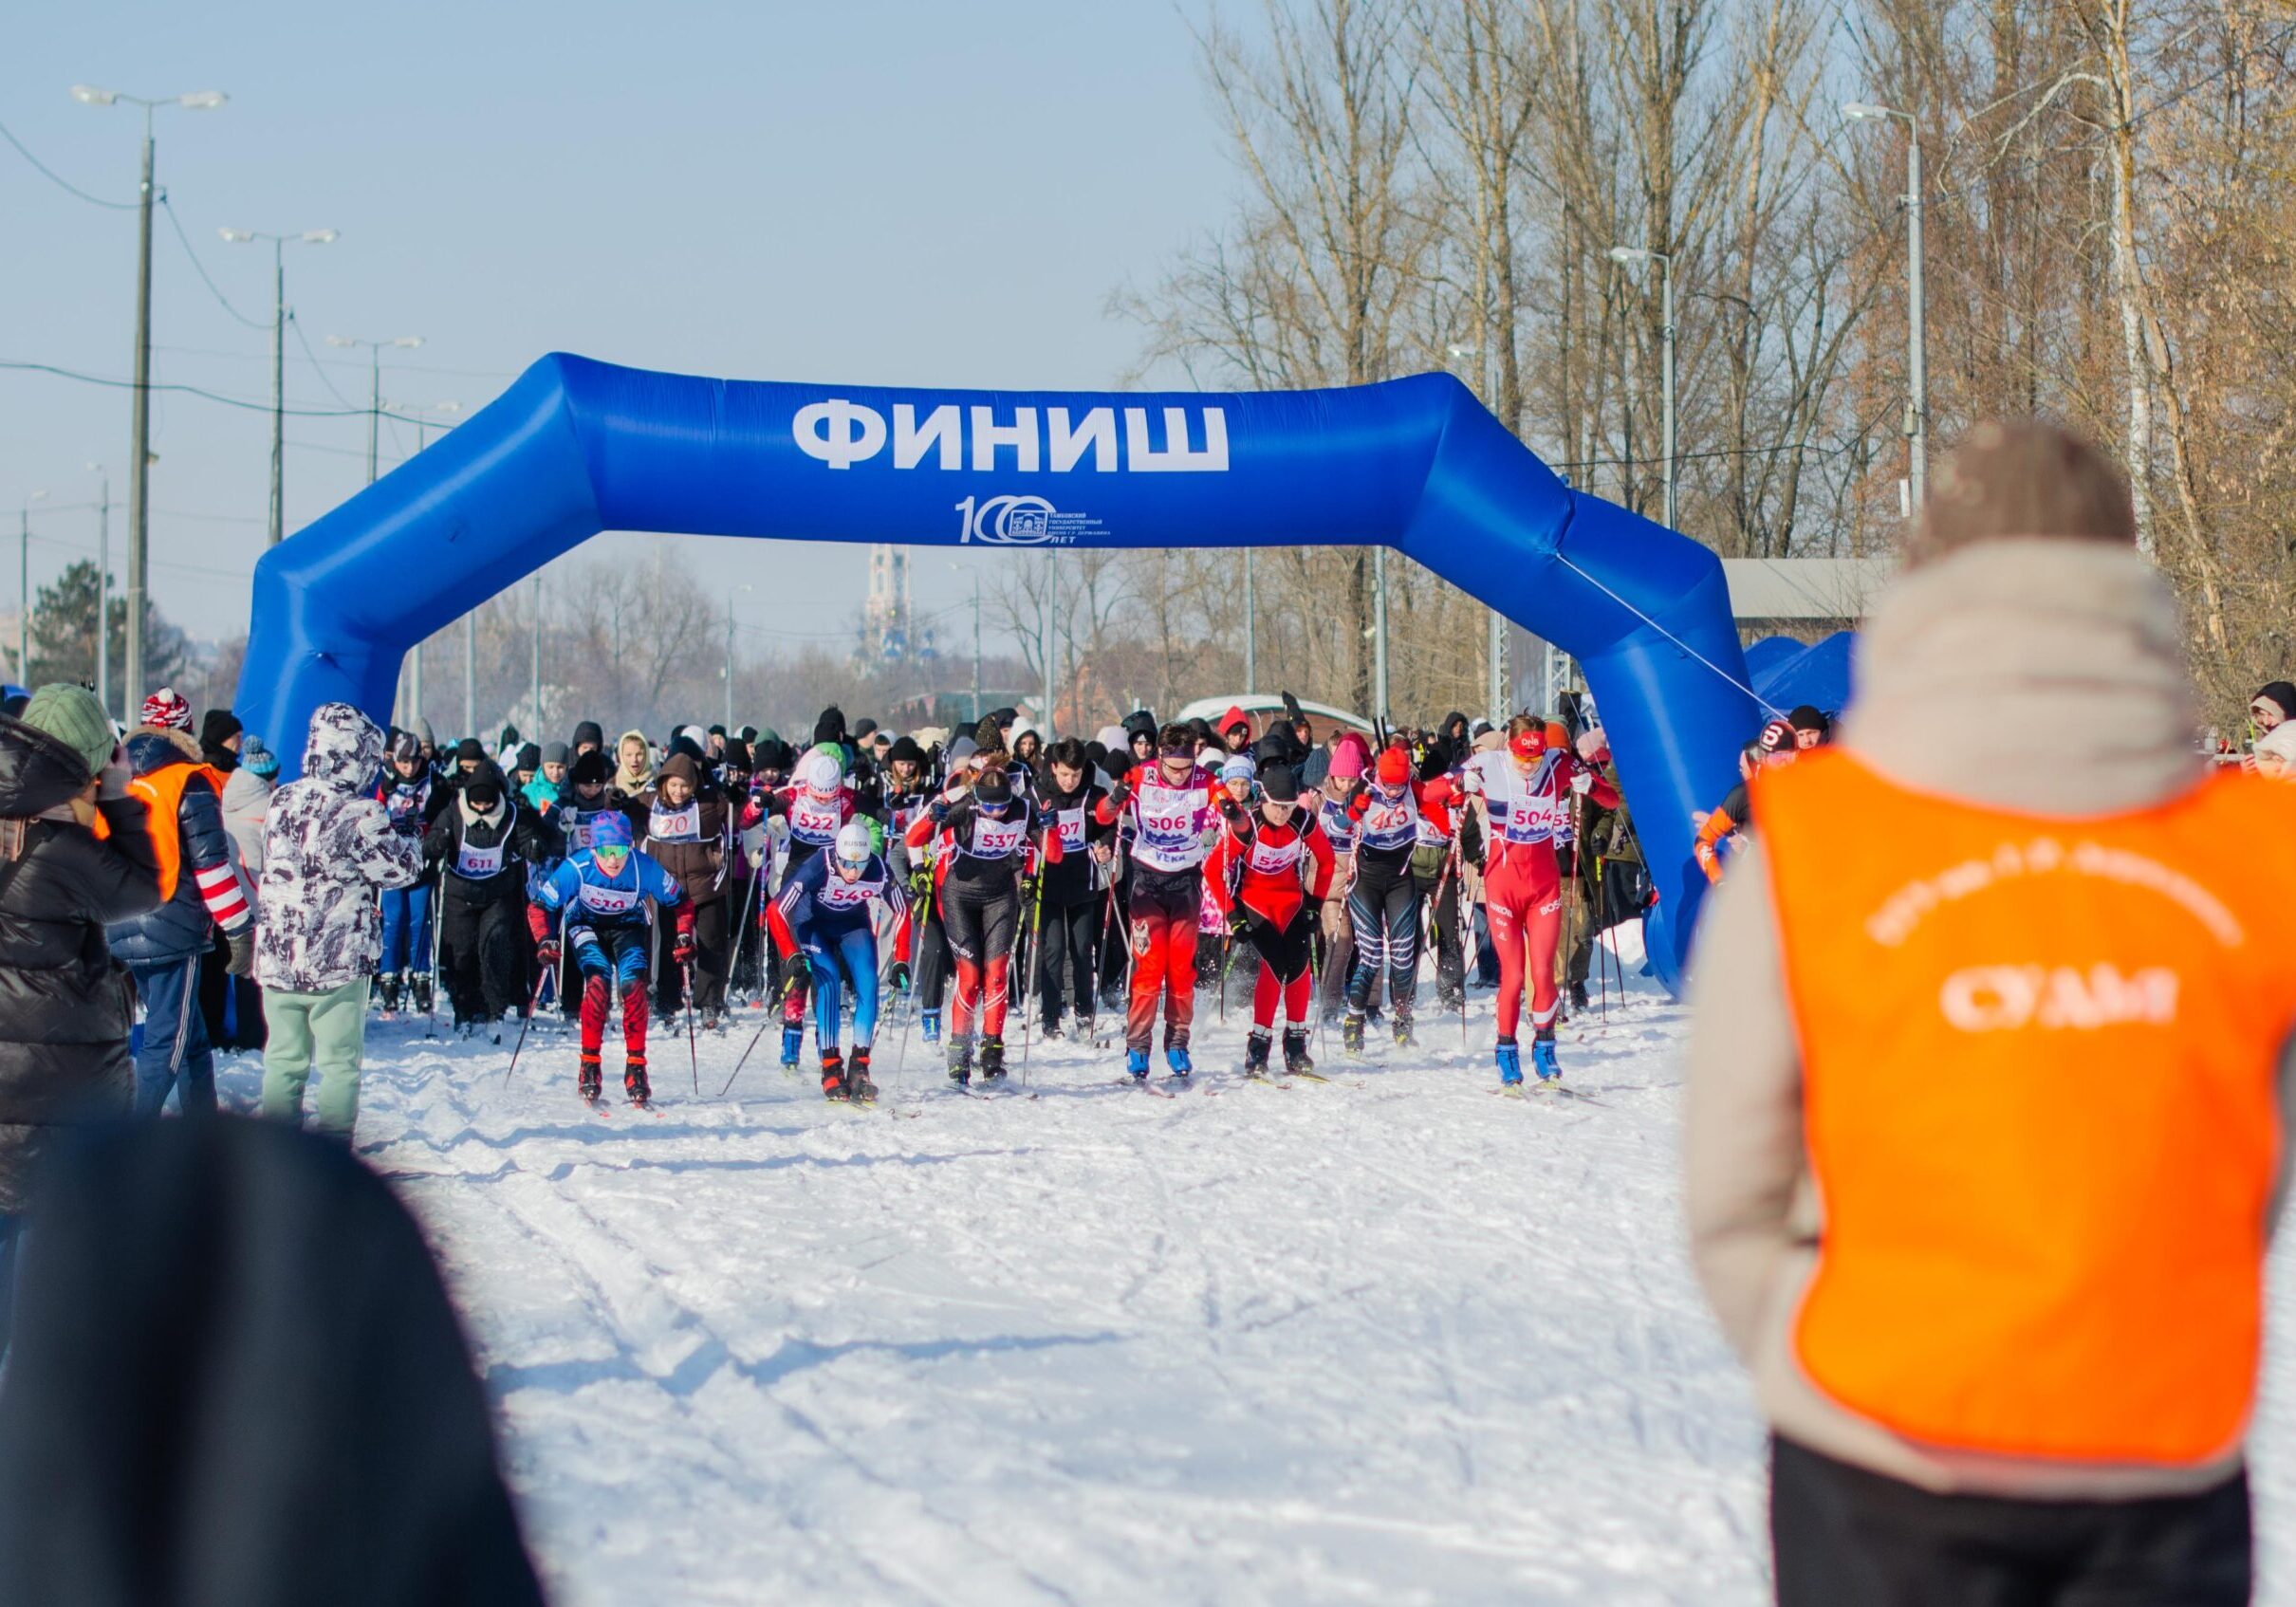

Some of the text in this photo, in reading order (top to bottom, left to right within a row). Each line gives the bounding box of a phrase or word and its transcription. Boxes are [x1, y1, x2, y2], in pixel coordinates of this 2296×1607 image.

[792, 398, 1230, 472] ФИНИШ
[954, 494, 1057, 544] 100
[799, 812, 834, 831] 522
[1148, 815, 1186, 831] 506
[1370, 802, 1409, 831] 415
[1513, 808, 1552, 826] 504
[982, 833, 1018, 848] 537
[467, 859, 493, 869] 611
